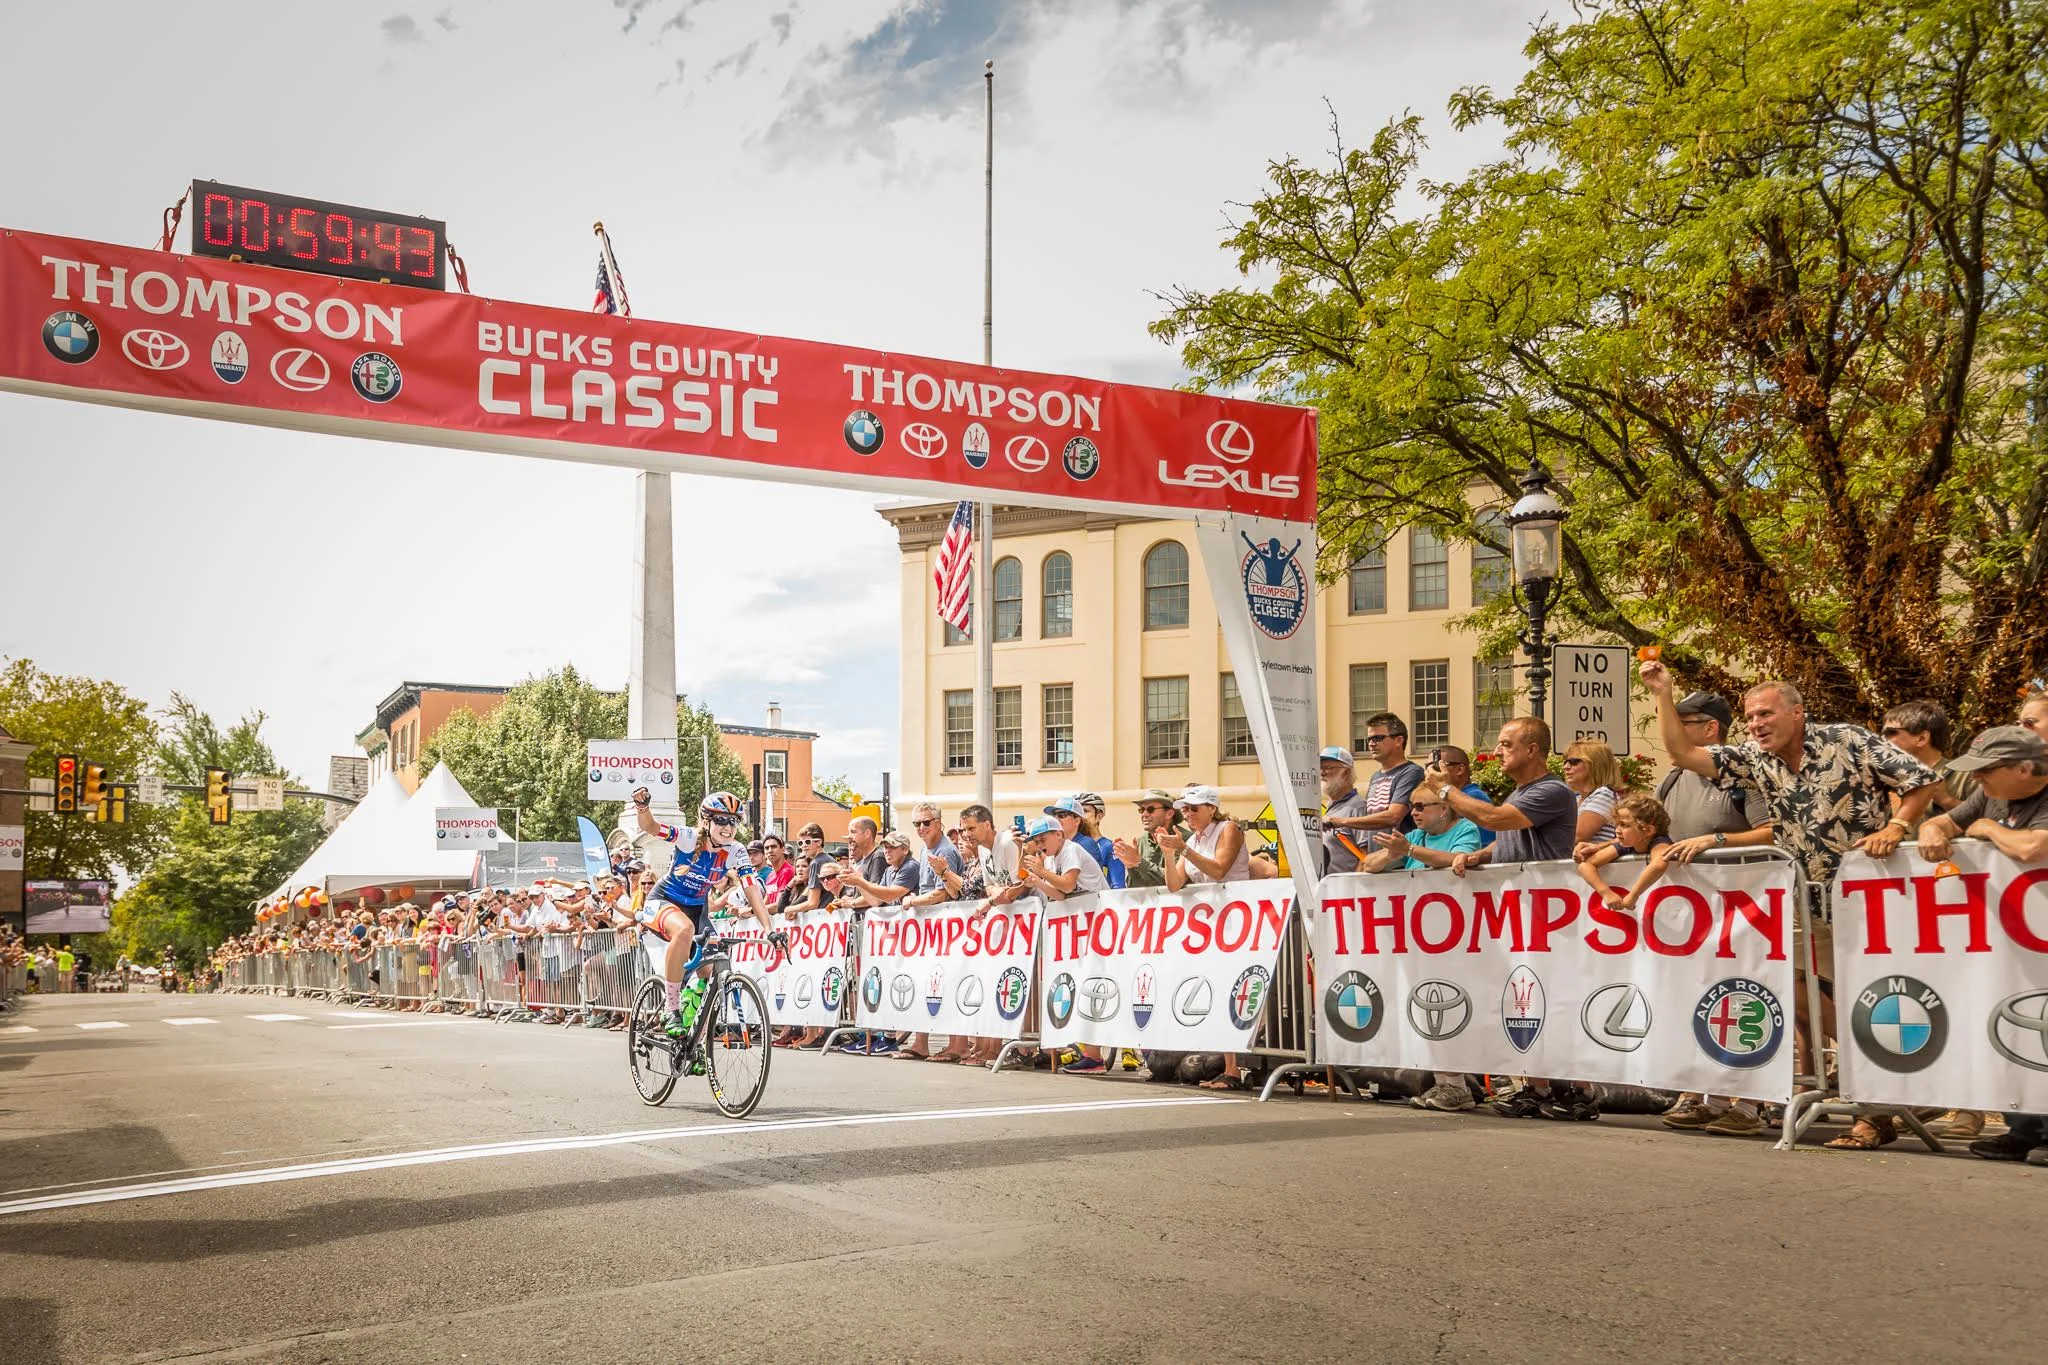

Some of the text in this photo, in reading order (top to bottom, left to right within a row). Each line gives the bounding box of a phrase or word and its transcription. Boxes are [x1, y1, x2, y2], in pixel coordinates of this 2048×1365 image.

[204, 193, 435, 278] 00:59:43
[42, 255, 403, 346] THOMPSON
[48, 312, 96, 332] BMW
[478, 321, 778, 384] BUCKS COUNTY
[215, 363, 245, 373] MASERATI
[353, 354, 400, 381] ALFA ROMEO
[478, 358, 778, 443] CLASSIC
[843, 363, 1101, 432] THOMPSON
[1158, 459, 1300, 499] LEXUS
[1250, 584, 1296, 599] THOMPSON
[1253, 596, 1272, 606] BUCKS
[1254, 604, 1296, 620] CLASSIC
[1292, 664, 1312, 675] Health
[1575, 653, 1608, 673] NO
[1569, 681, 1613, 698] TURN
[1579, 705, 1603, 722] ON
[590, 756, 674, 769] THOMPSON
[436, 819, 497, 828] THOMPSON
[0, 838, 22, 847] SON
[867, 911, 1037, 958] THOMPSON
[1047, 897, 1291, 961] THOMPSON
[1321, 884, 1787, 961] THOMPSON
[735, 921, 849, 962] THOPSON
[1231, 970, 1250, 998] ALFA
[1330, 972, 1378, 996] BMW
[1859, 977, 1941, 1010] BMW
[1697, 980, 1783, 1027] ALFA ROMEO
[707, 1057, 729, 1108] BONTRGER
